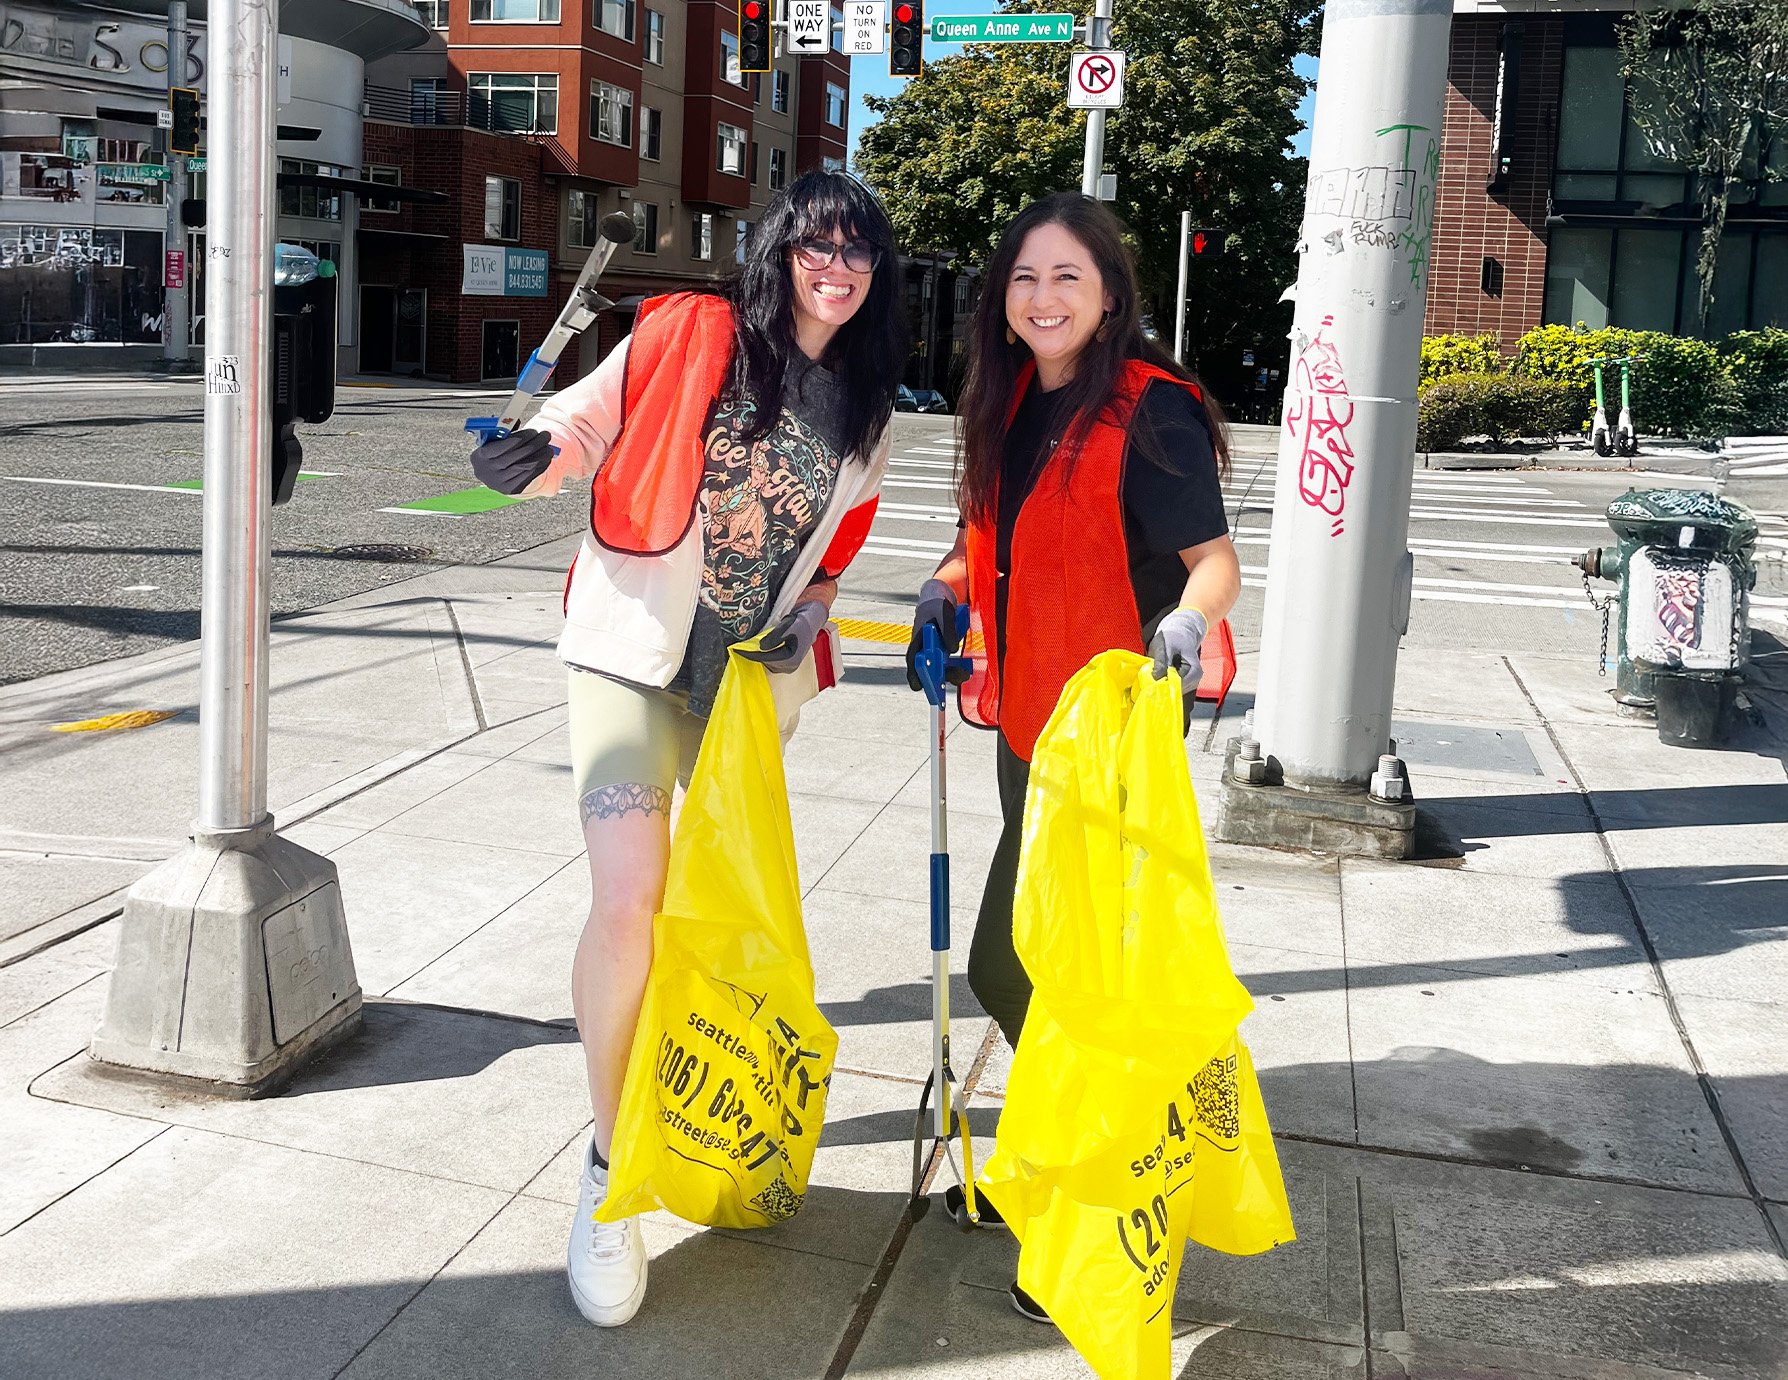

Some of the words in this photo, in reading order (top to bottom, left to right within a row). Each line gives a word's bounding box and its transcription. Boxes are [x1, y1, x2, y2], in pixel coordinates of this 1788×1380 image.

[795, 3, 823, 17] ONE
[856, 5, 873, 15] NO
[794, 19, 824, 32] WAY
[853, 18, 876, 27] TURN
[857, 29, 870, 38] ON
[936, 21, 977, 37] Queen
[984, 20, 1020, 36] Anne
[1028, 22, 1051, 36] Ave
[1057, 22, 1068, 35] N
[854, 41, 873, 50] RED
[508, 255, 522, 270] NOW
[522, 256, 545, 272] LEASING
